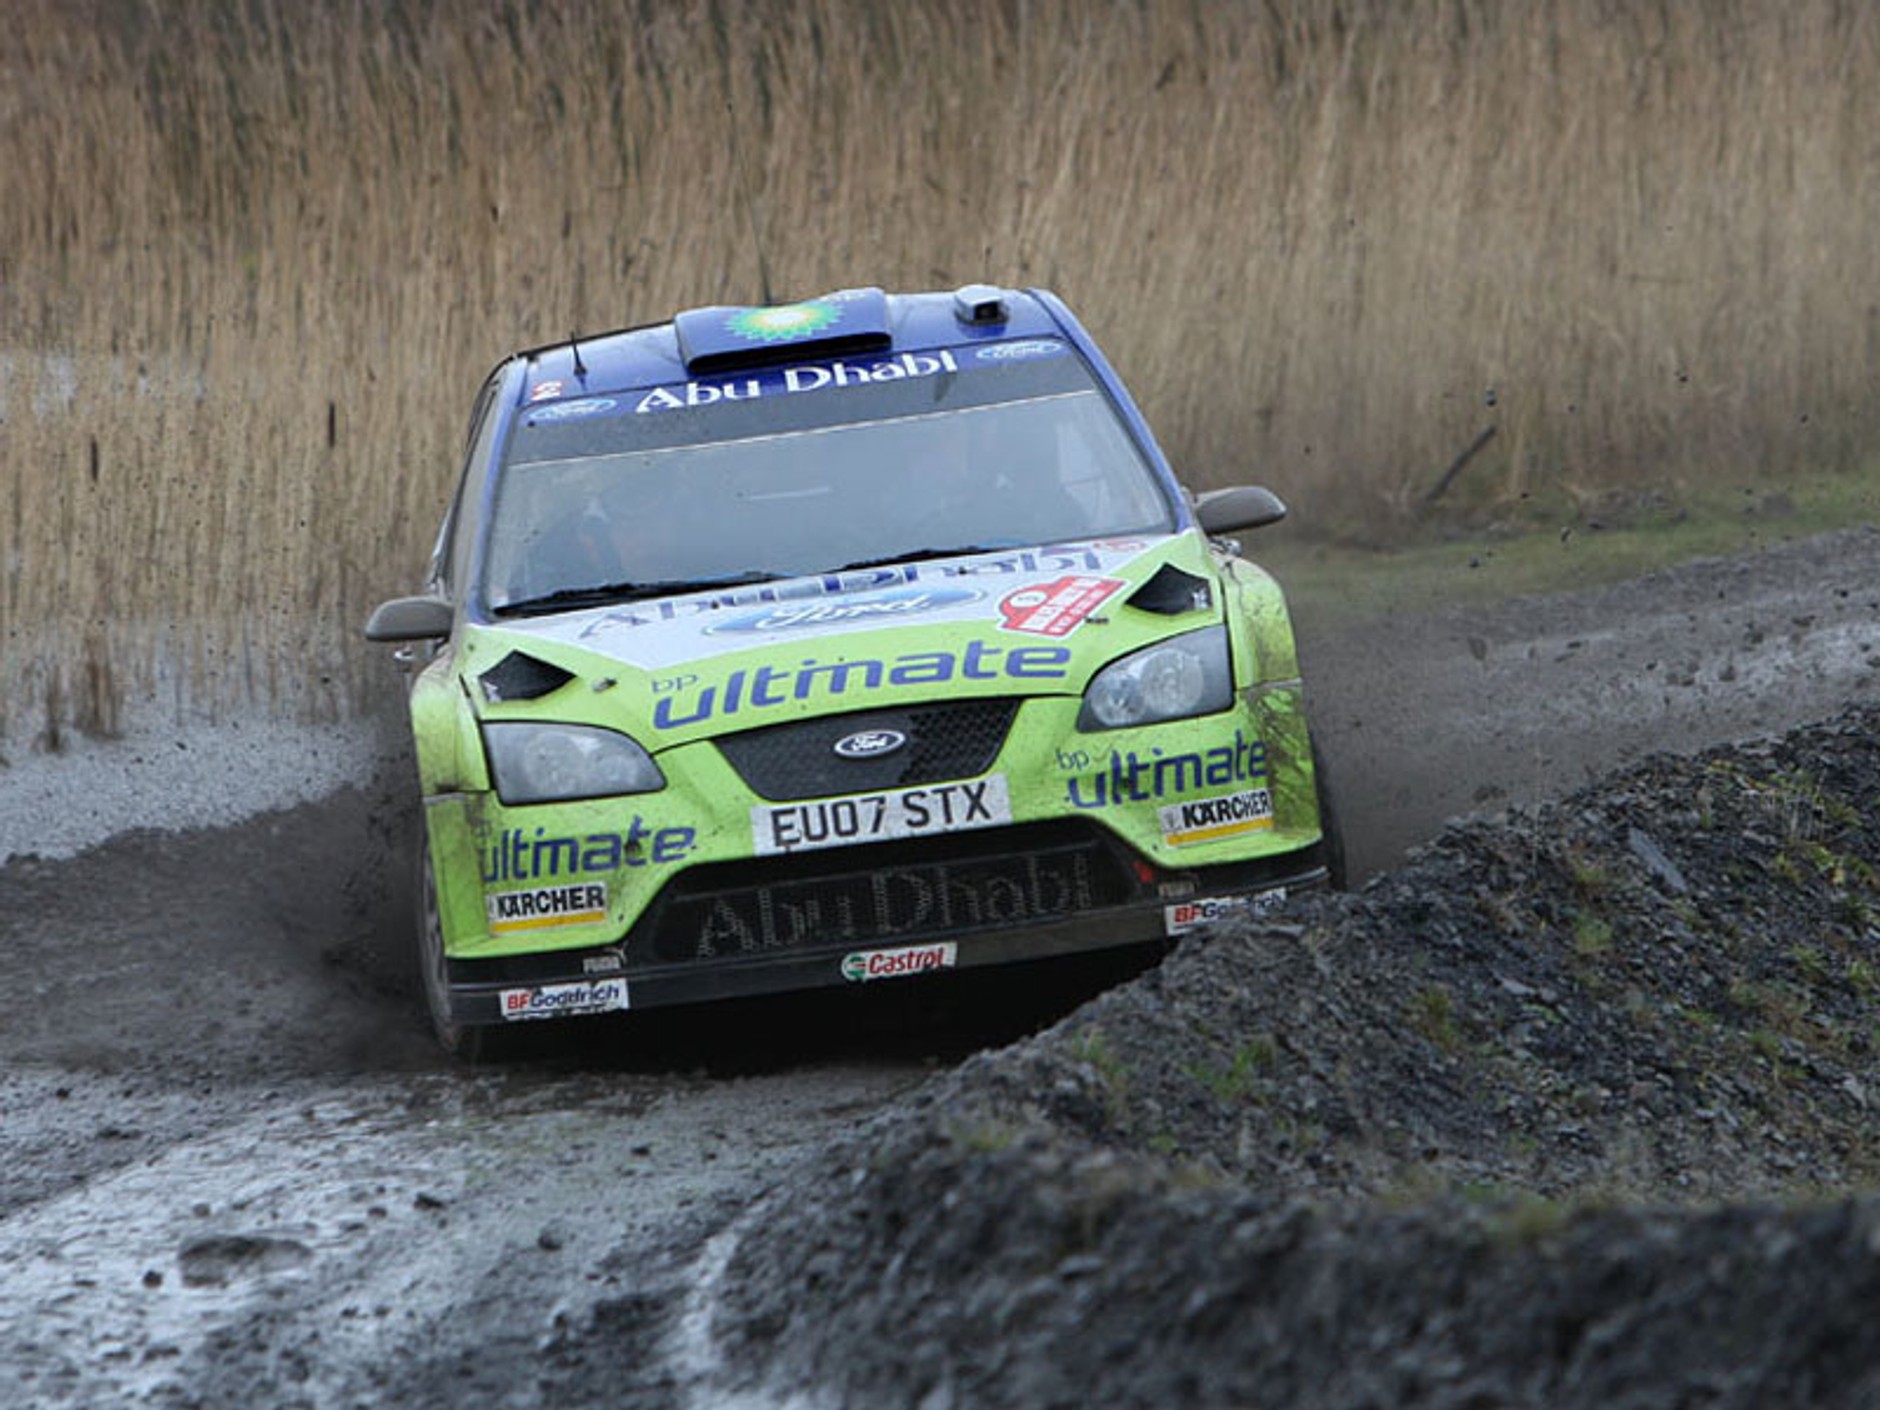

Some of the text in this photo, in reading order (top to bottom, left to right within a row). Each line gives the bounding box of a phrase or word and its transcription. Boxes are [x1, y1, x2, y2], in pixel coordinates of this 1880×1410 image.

[634, 379, 761, 414] Abu
[652, 672, 699, 694] bp
[652, 639, 1072, 731] ultimate
[1055, 748, 1090, 771] bp
[1067, 728, 1270, 809] ultimate
[770, 781, 991, 848] EU07 STX
[868, 949, 947, 977] Castrol
[507, 984, 620, 1011] BFGoodrich
